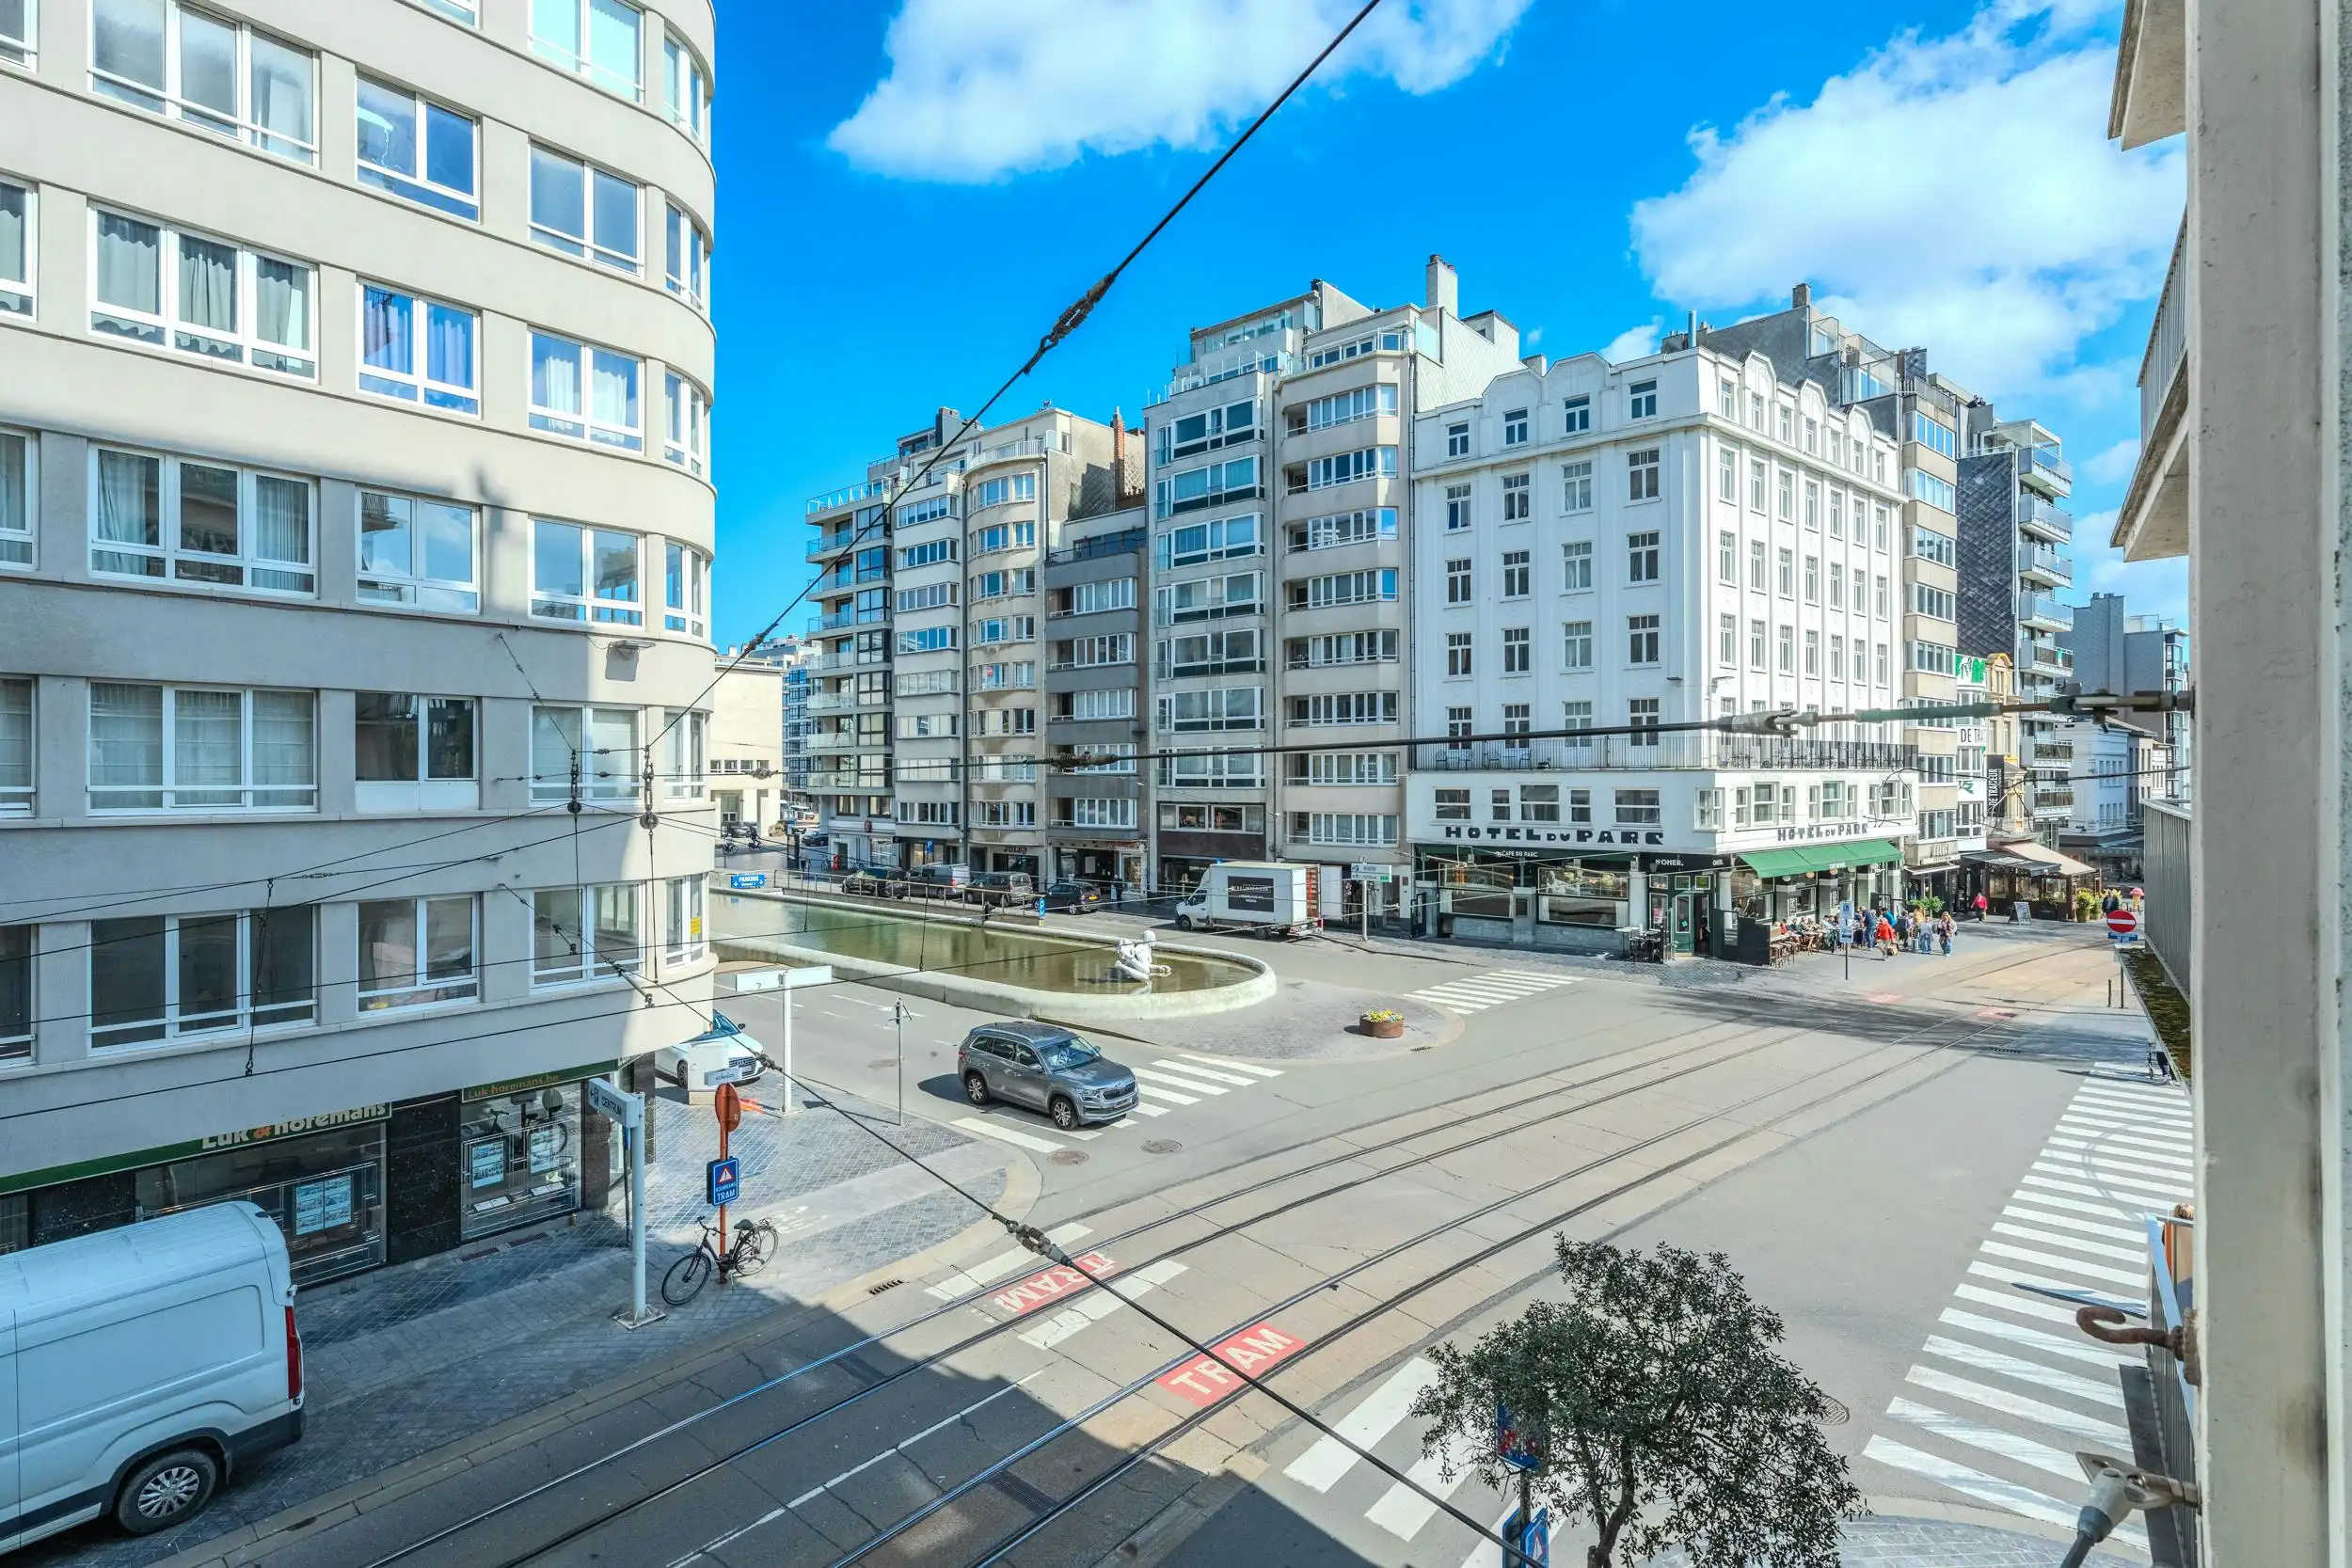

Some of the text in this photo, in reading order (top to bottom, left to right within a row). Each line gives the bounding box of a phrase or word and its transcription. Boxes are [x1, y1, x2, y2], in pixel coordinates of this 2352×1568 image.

[1960, 728, 1972, 743] DE
[1988, 798, 1998, 806] DE
[1445, 826, 1664, 845] HOTEL DU PARC
[1777, 826, 1823, 842] HOTEL
[601, 1097, 623, 1117] CENTRUM
[716, 1189, 736, 1202] TRAM
[1169, 1327, 1294, 1395] TRAM
